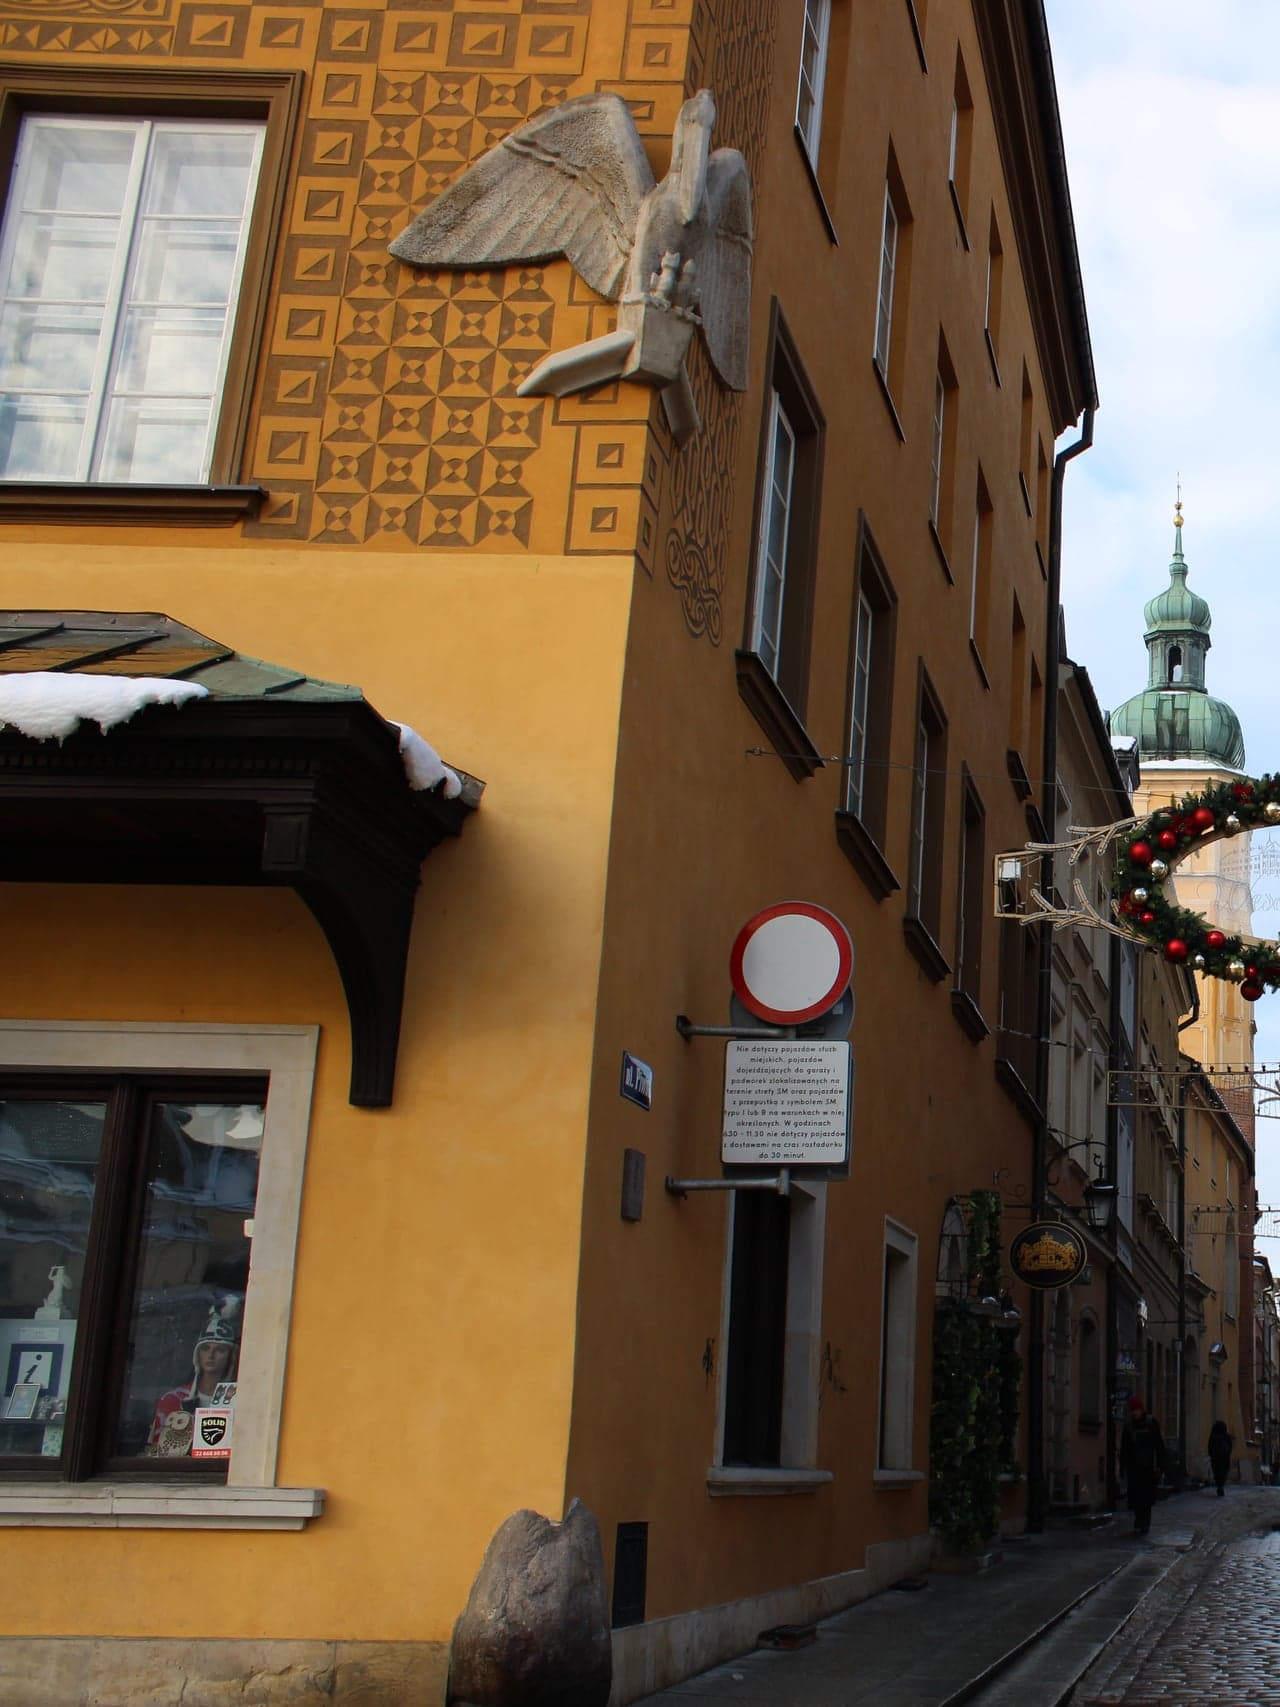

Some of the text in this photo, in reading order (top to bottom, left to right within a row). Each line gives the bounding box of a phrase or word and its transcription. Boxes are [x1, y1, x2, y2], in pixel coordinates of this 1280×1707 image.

[751, 1046, 779, 1054] dotyczy
[754, 1088, 775, 1096] strefy
[793, 1120, 832, 1128] godzinach
[202, 1418, 226, 1427] SOLID
